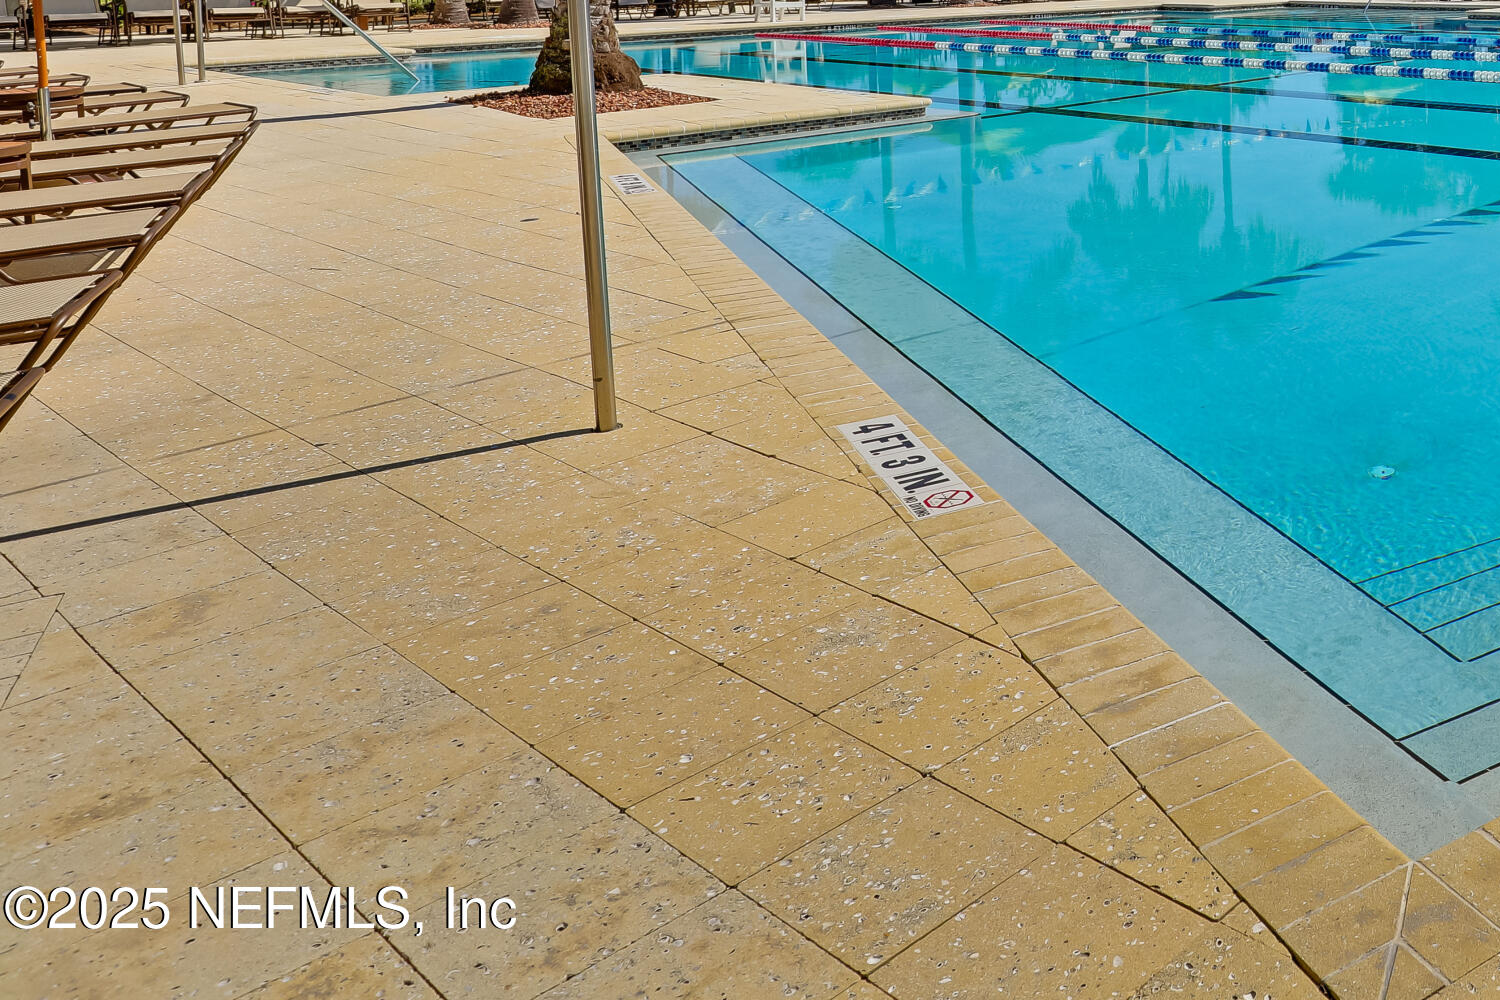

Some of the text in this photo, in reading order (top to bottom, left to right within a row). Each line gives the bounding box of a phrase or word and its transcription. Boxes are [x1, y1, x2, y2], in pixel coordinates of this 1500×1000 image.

[852, 422, 950, 494] 4 FT. 3 IN.
